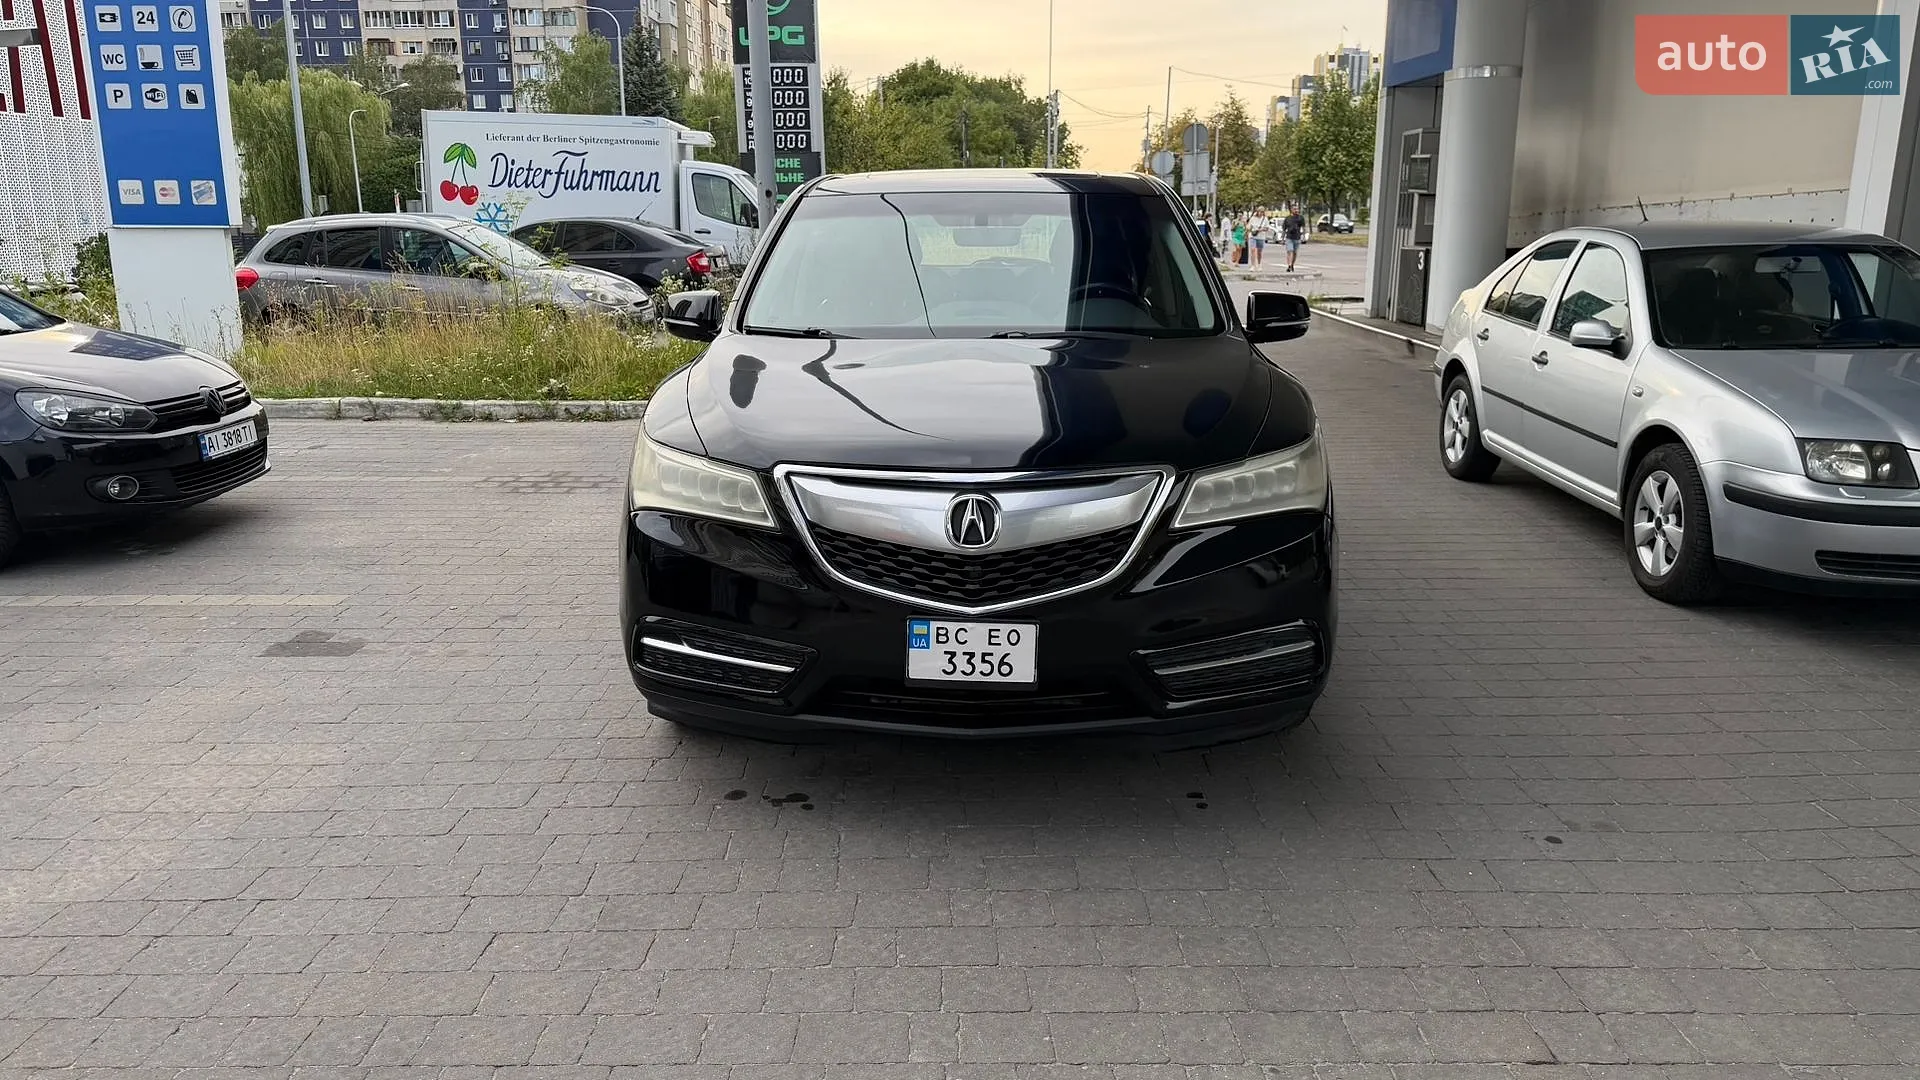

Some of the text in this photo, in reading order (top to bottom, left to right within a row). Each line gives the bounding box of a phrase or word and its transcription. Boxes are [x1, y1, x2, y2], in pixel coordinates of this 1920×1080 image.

[136, 11, 155, 24] 24
[103, 54, 124, 65] WC
[113, 89, 123, 103] P
[486, 133, 660, 146] Lieferant der Berliner Spitzengastronomie
[775, 158, 801, 168] СНЕ
[1418, 251, 1425, 270] 3
[208, 425, 253, 453] AI 3818 TI
[912, 638, 927, 648] UA
[935, 626, 1021, 647] BC EO
[941, 650, 1014, 678] 3356
